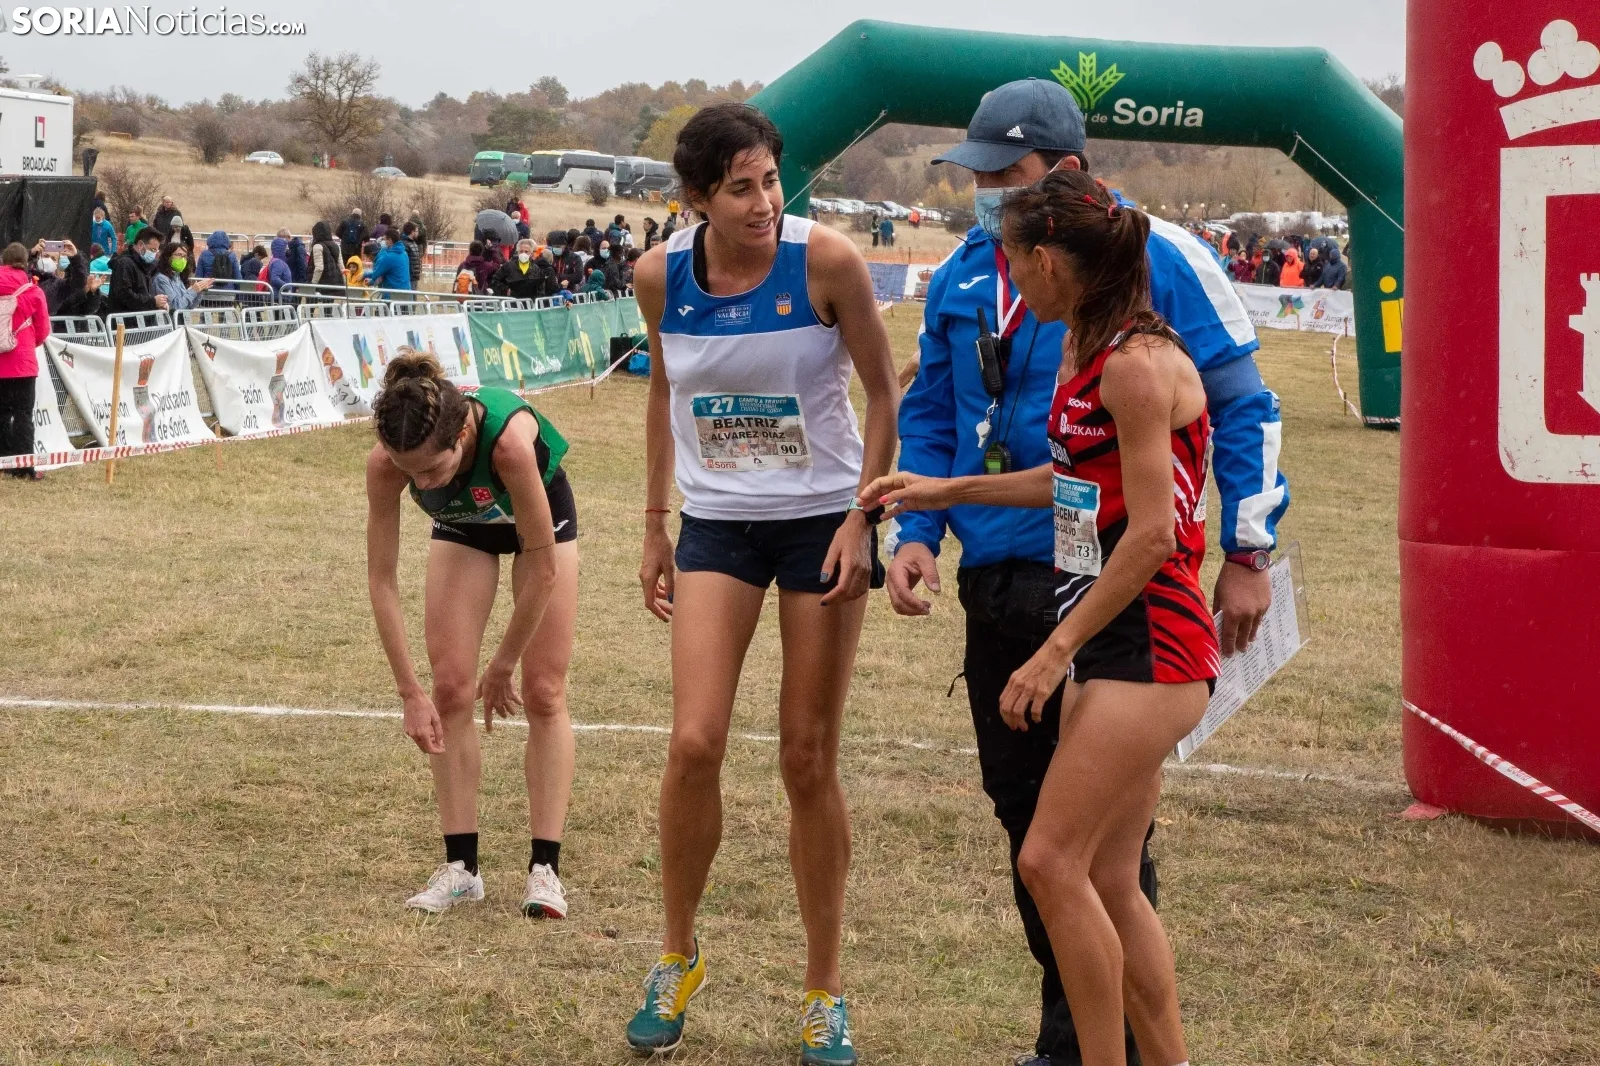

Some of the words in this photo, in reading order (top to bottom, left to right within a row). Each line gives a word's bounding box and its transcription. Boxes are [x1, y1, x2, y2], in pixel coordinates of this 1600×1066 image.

[1112, 97, 1204, 128] Soria
[22, 156, 57, 172] BROADCAST
[709, 396, 734, 414] 27
[157, 420, 168, 441] de
[169, 415, 191, 439] Soria
[713, 417, 780, 430] BEATRIZ
[1066, 424, 1106, 437] BIZKAIA
[711, 430, 760, 441] ALVAREZ
[780, 444, 798, 455] 90
[1076, 544, 1090, 558] 73
